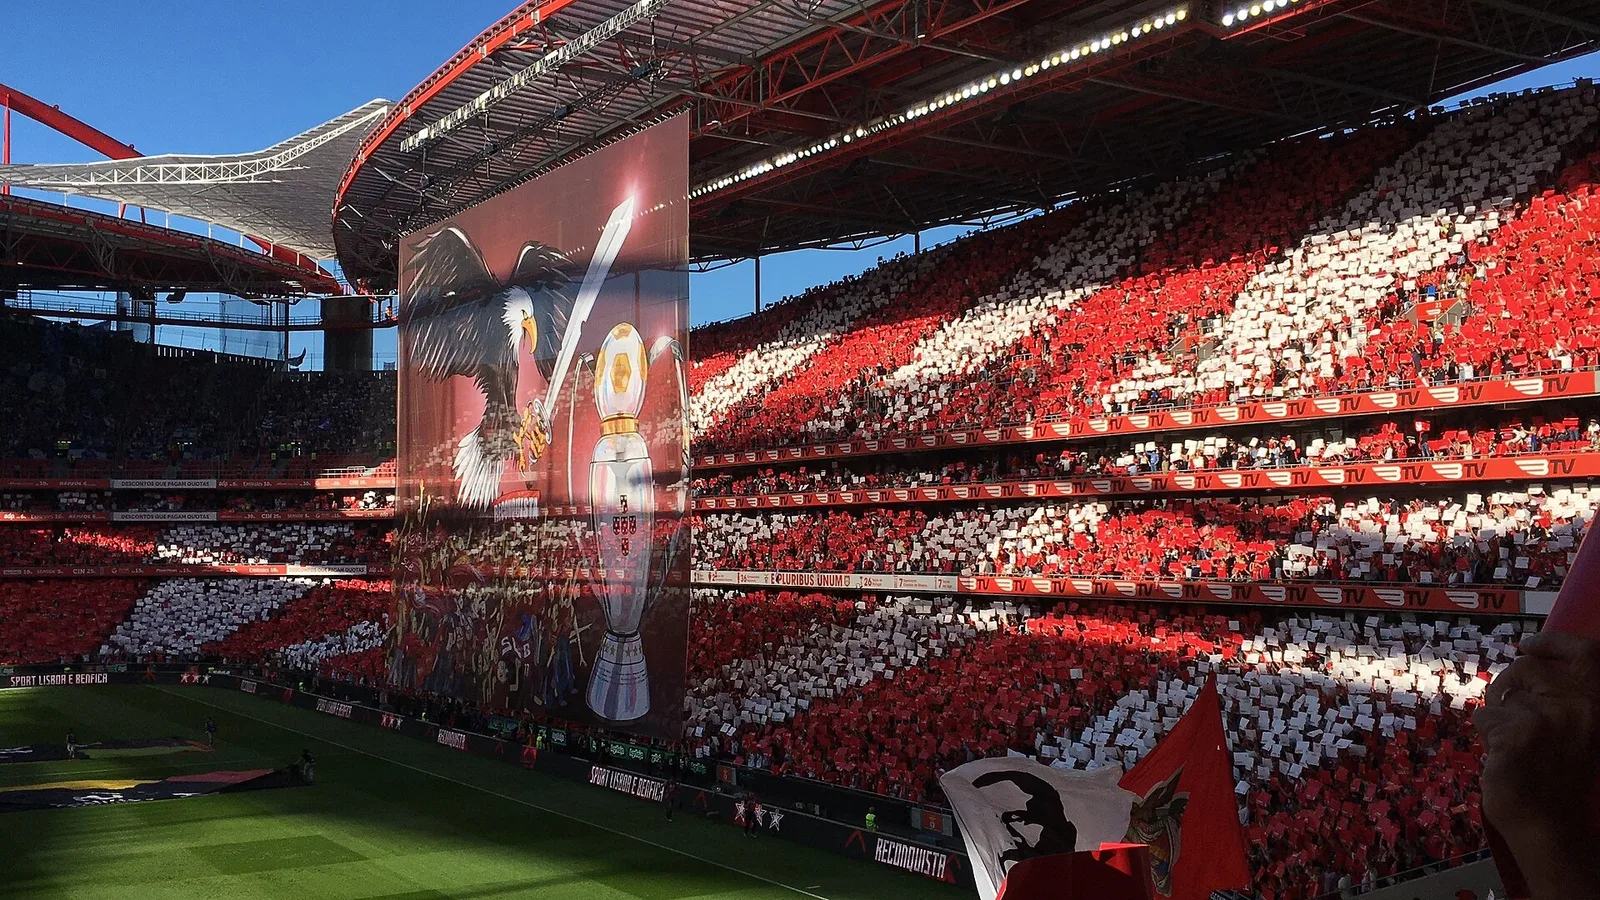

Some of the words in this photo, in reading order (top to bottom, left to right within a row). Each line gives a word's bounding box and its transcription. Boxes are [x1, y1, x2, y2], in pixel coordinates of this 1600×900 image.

[778, 573, 814, 586] PLURIBUS
[817, 574, 843, 586] UNUM
[864, 577, 872, 586] 26
[11, 676, 36, 687] SPORT
[39, 675, 66, 686] LISBOA
[69, 674, 74, 684] E
[76, 673, 108, 684] BENFICA
[590, 766, 610, 787] SPORT
[610, 771, 632, 793] LISBOA
[631, 776, 638, 795] E
[637, 778, 664, 802] BENFICA
[875, 838, 947, 878] RECONQUISTA
